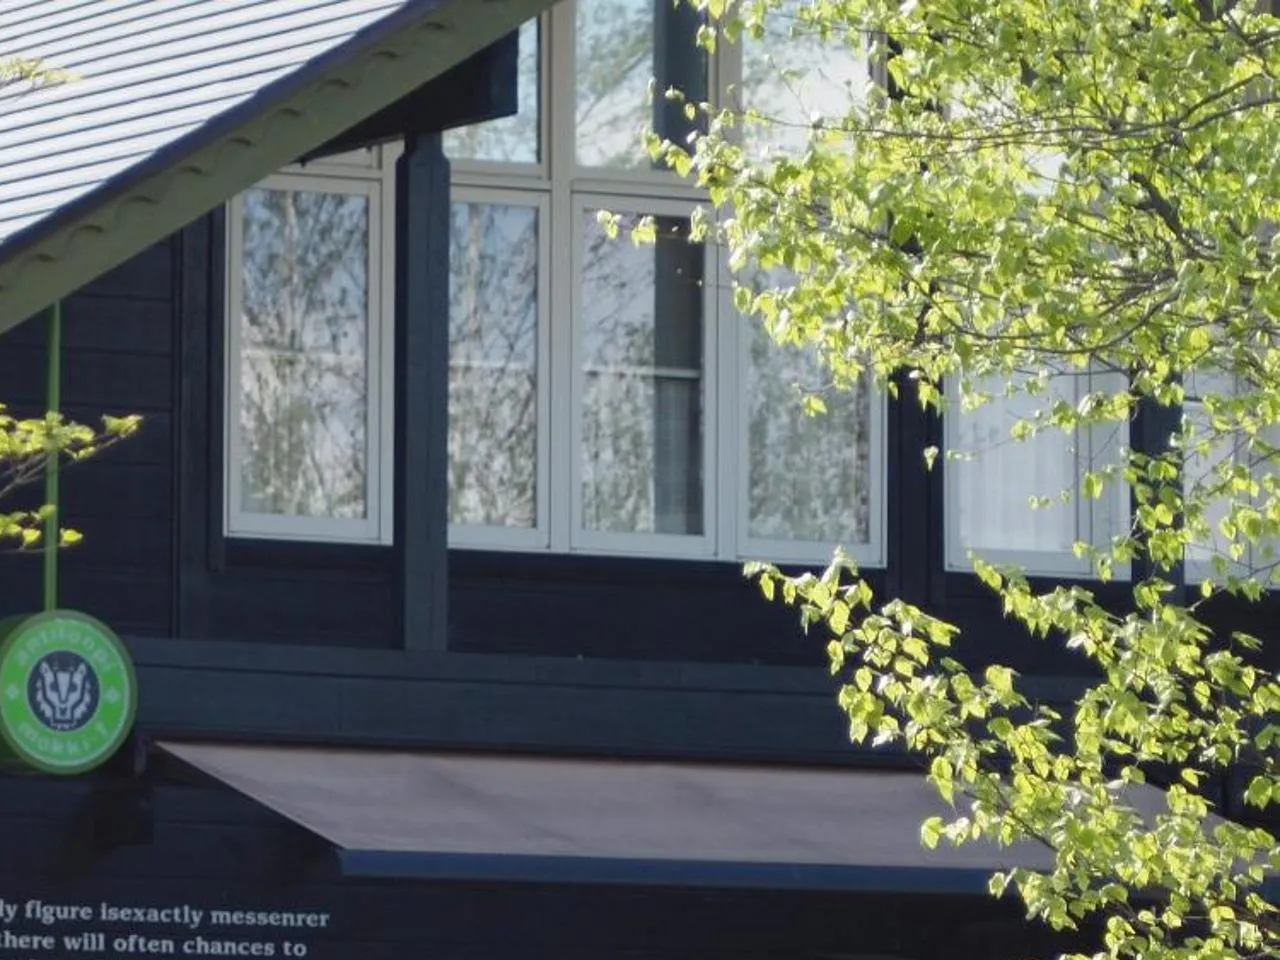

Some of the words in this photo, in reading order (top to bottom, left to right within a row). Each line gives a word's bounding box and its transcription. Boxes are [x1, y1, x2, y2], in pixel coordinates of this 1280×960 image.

[25, 900, 92, 924] figure
[64, 932, 104, 951] will
[113, 934, 174, 954] often
[183, 936, 275, 956] chances
[283, 941, 307, 956] to
